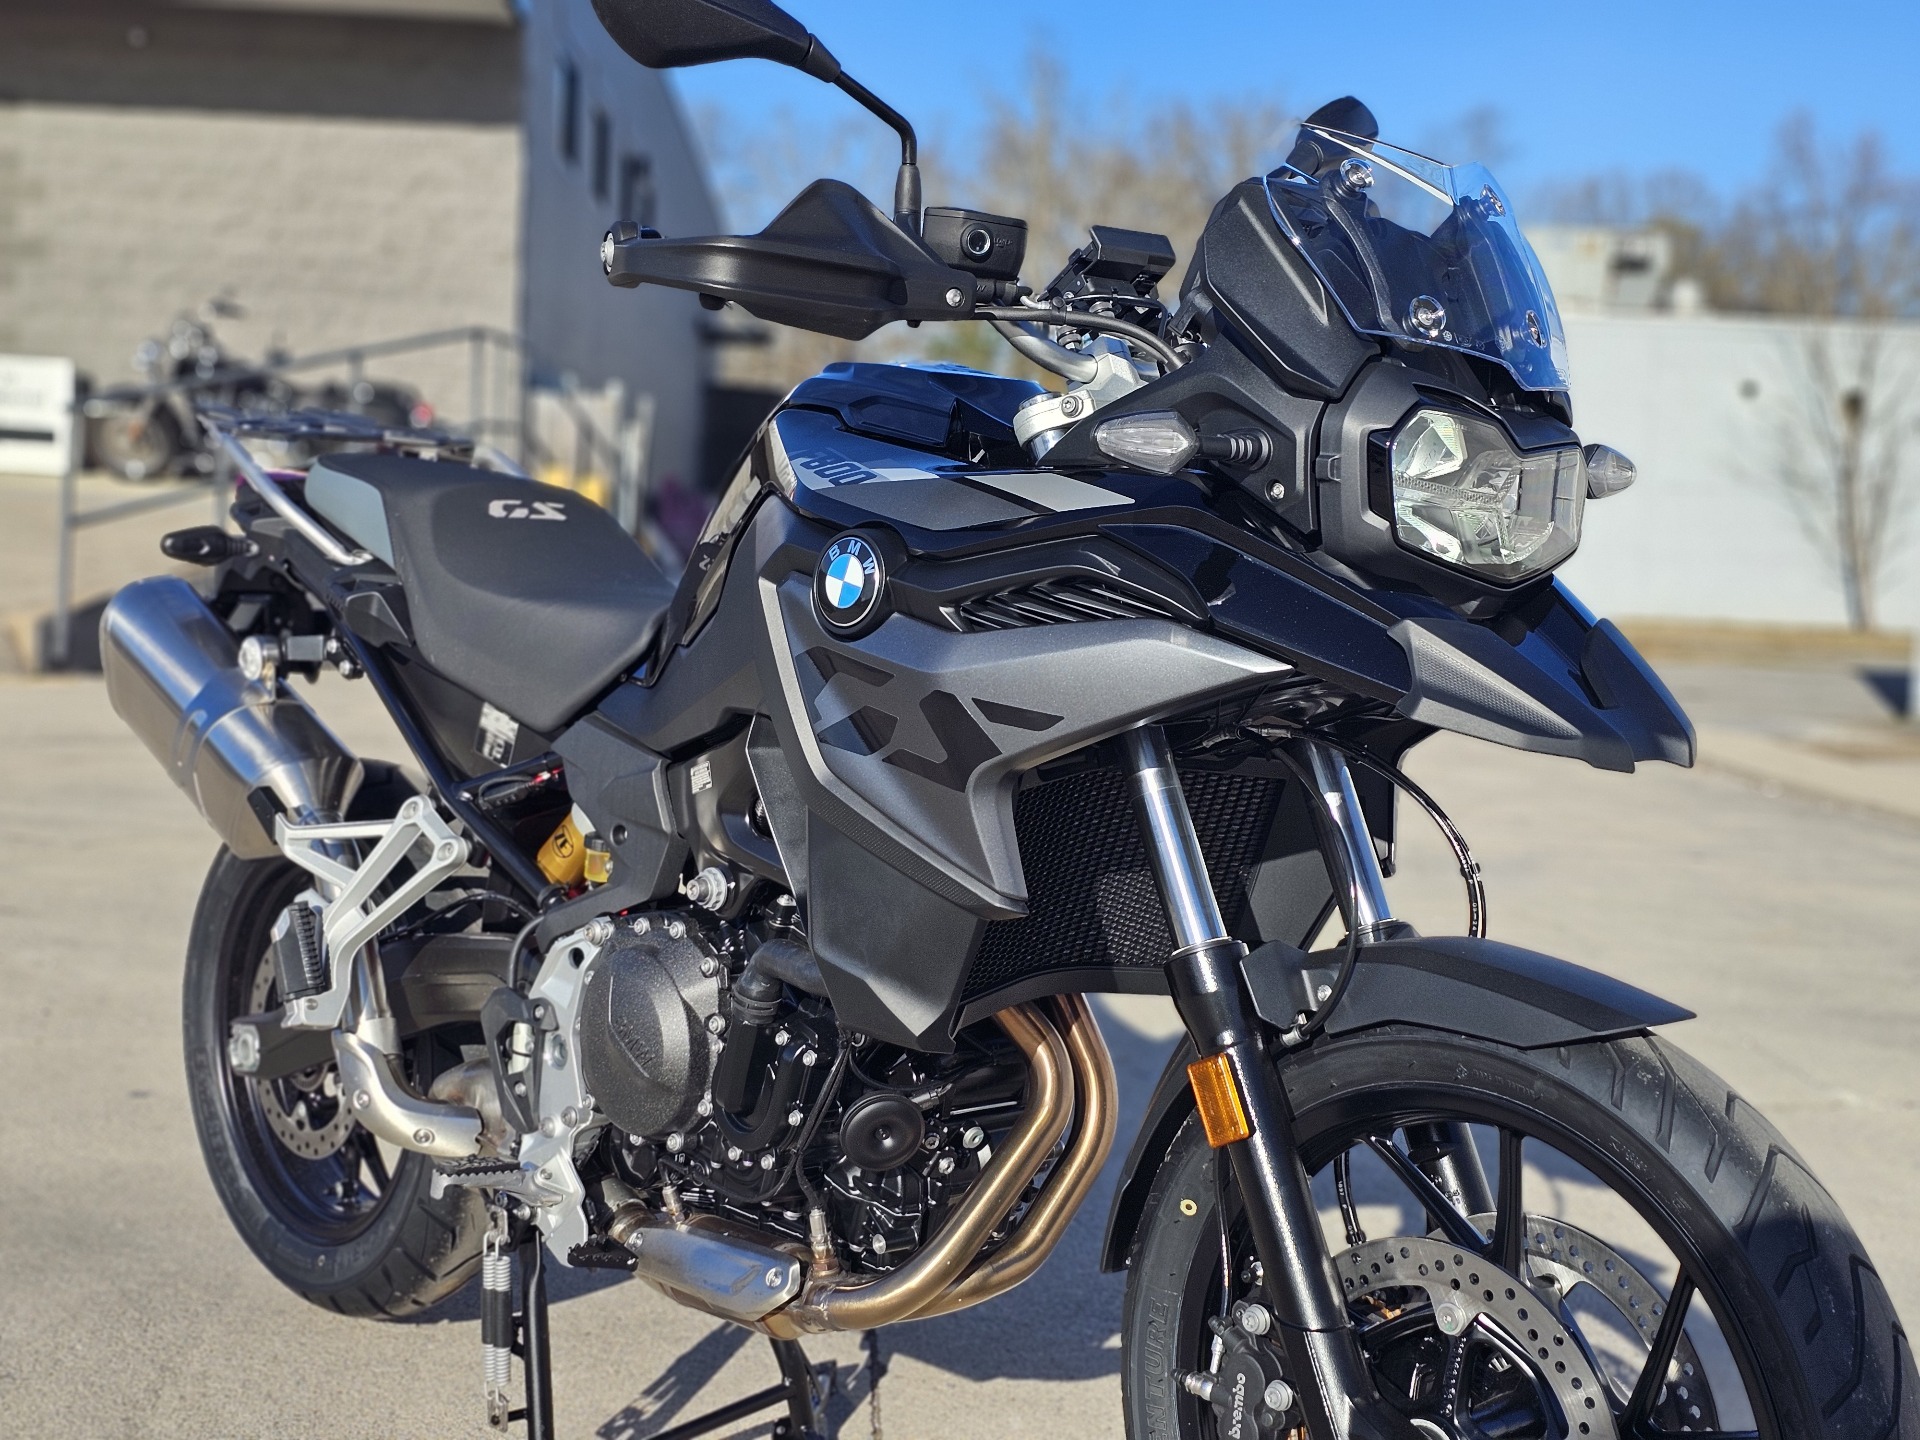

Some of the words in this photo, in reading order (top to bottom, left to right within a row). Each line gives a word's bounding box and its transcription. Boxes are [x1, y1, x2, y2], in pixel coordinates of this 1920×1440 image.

[488, 499, 566, 520] GS
[828, 539, 875, 575] BMW
[1227, 1372, 1246, 1440] brembo
